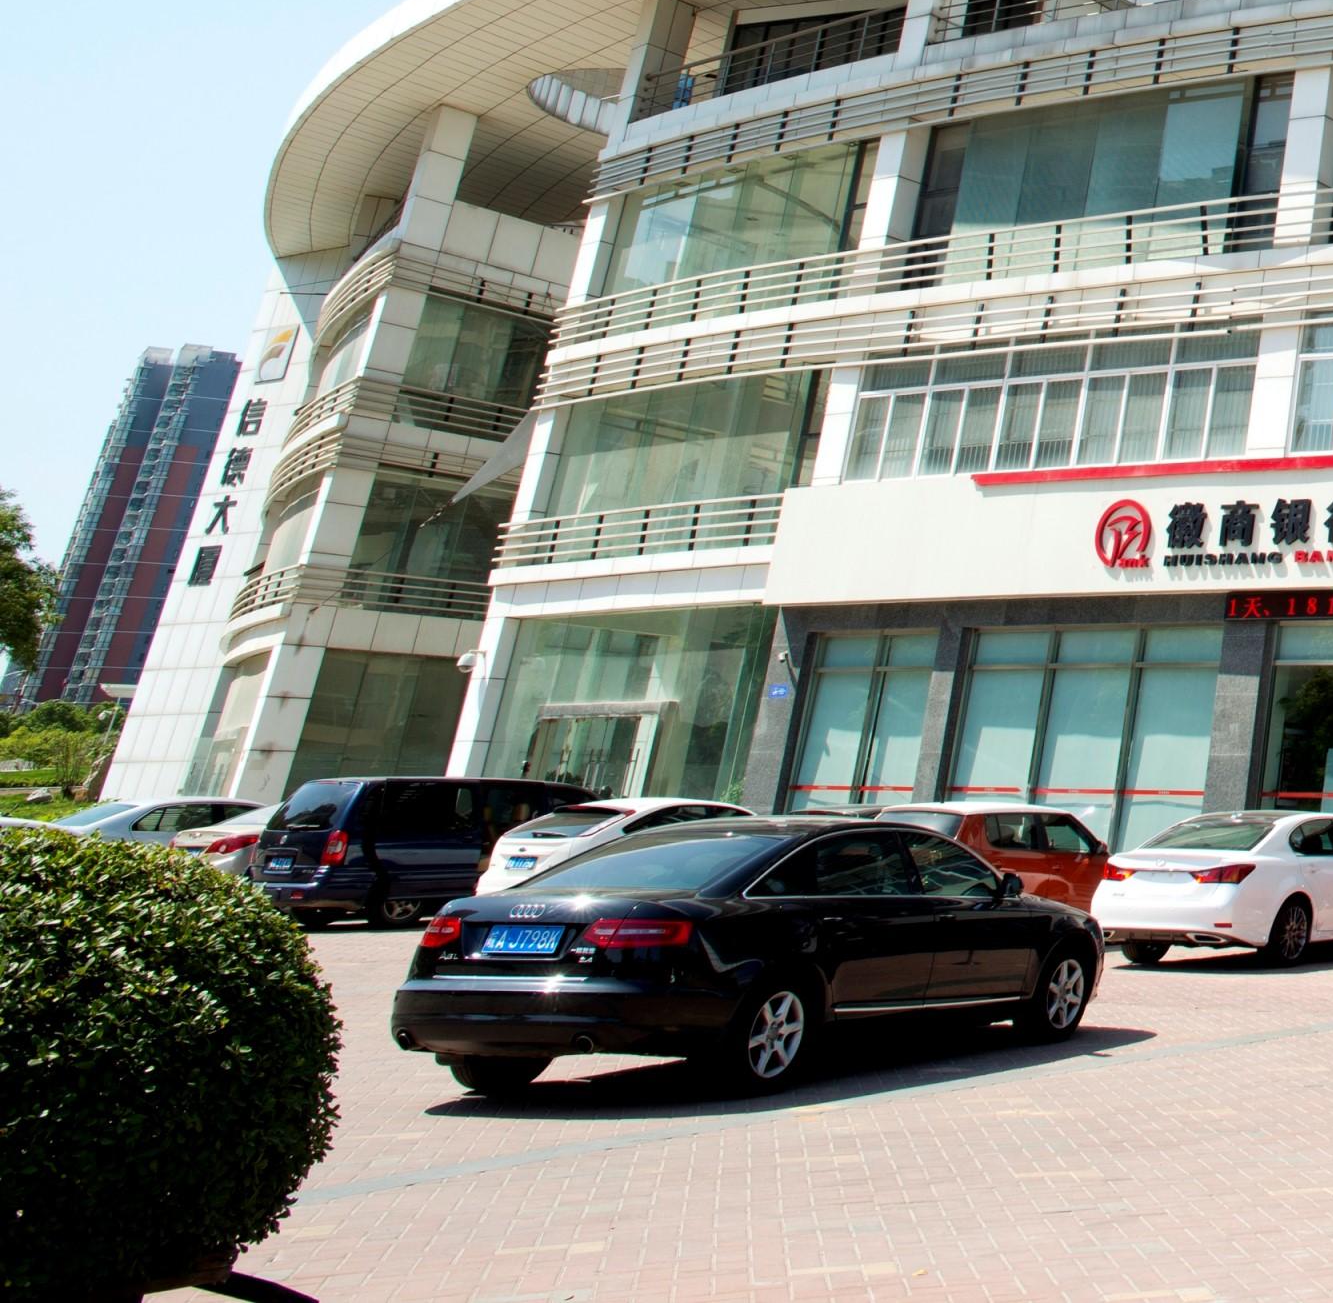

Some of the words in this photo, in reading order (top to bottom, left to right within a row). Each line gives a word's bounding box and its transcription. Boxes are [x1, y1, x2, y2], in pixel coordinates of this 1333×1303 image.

[187, 398, 268, 586] 信德大厦
[1163, 551, 1284, 567] HUISHANG
